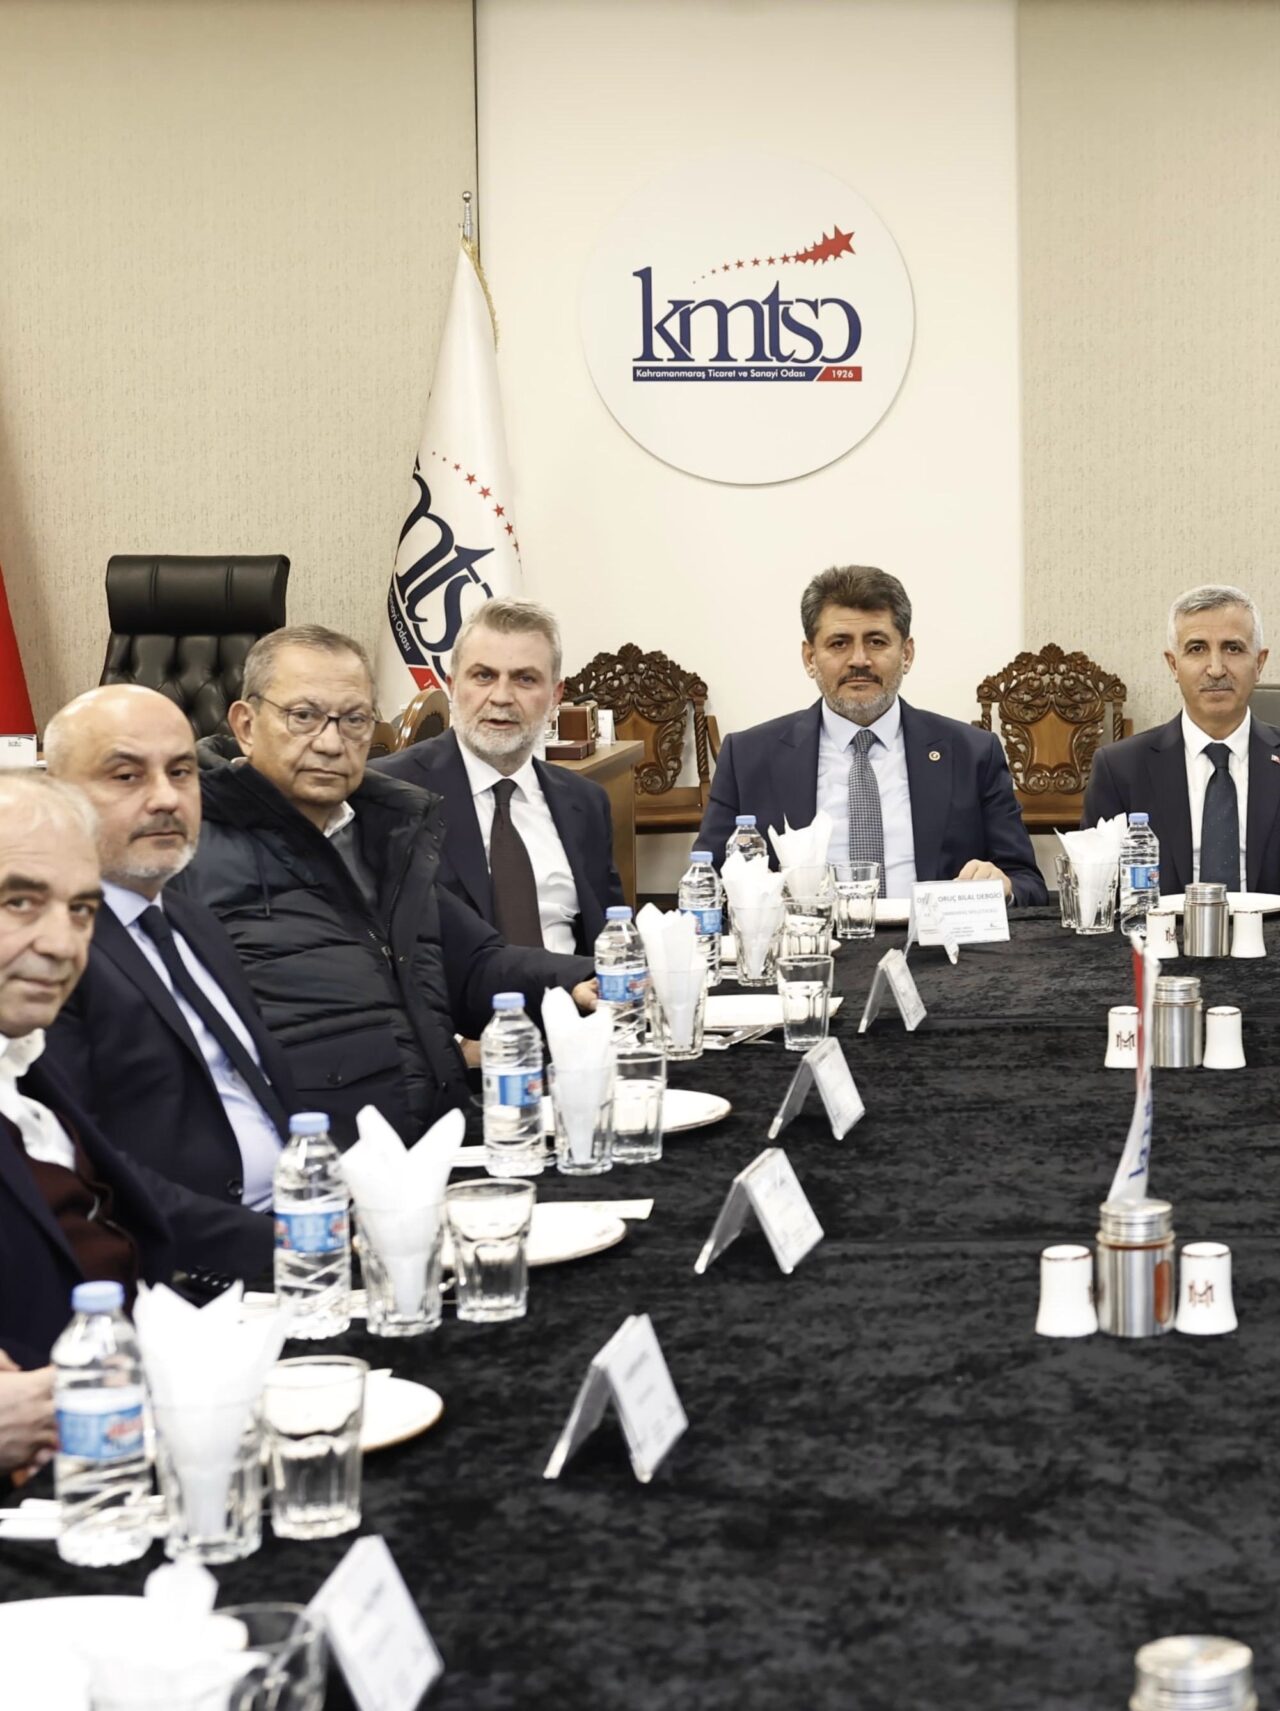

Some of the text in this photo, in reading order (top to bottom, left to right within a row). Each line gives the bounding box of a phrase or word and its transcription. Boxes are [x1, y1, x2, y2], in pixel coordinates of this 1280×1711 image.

[636, 368, 706, 380] Kahramanmaraş
[708, 369, 736, 378] Ticaret
[750, 369, 778, 380] Sanayi
[780, 369, 806, 378] Odası
[831, 369, 854, 378] 1926
